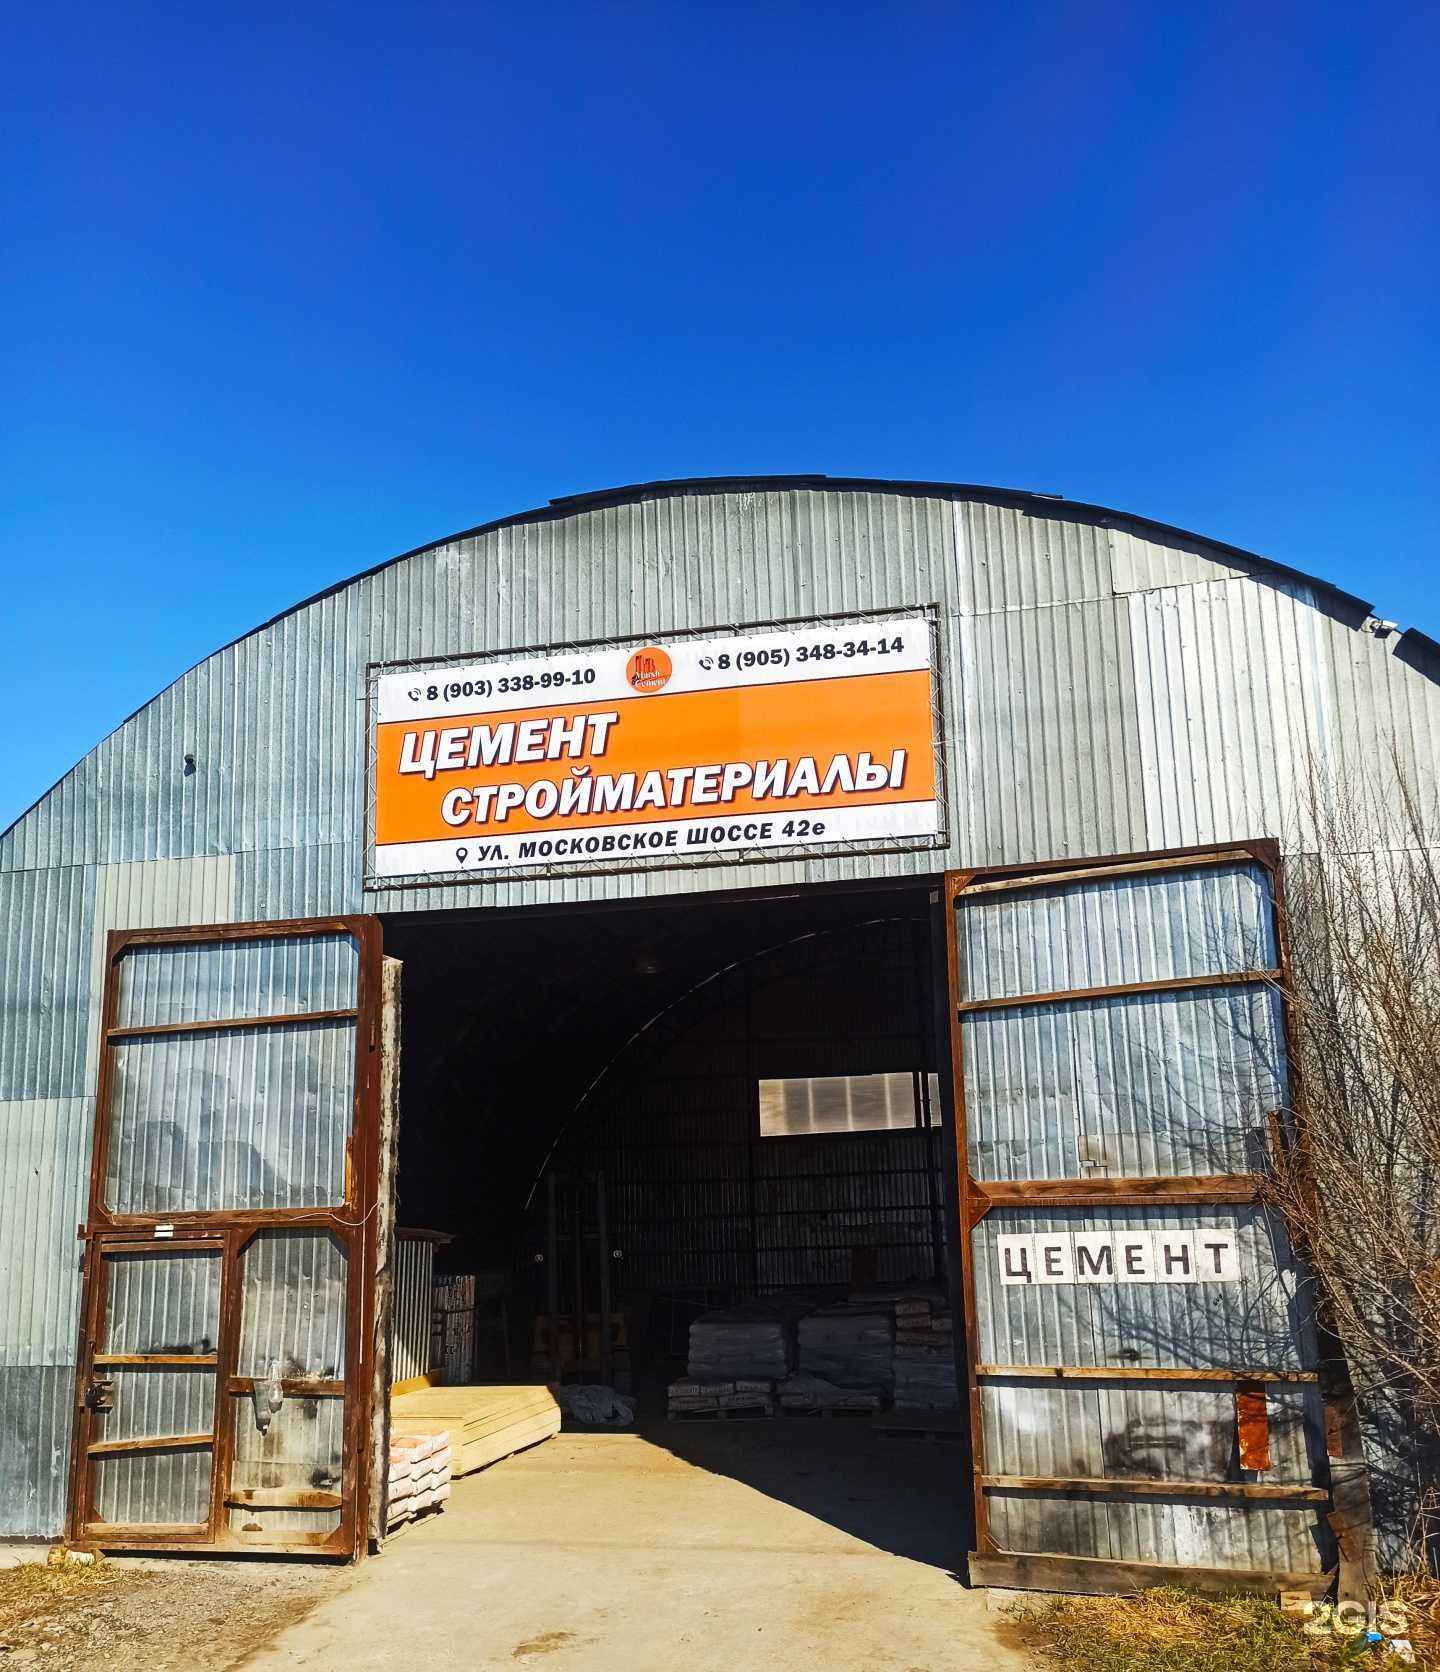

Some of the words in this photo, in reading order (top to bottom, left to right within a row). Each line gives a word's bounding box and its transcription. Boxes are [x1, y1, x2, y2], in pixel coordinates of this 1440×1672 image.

[718, 654, 731, 669] 8
[736, 648, 790, 671] (905)
[795, 636, 905, 662] 348-34-14
[426, 685, 439, 701] 8
[443, 679, 493, 702] (903)
[497, 668, 596, 693] 338-99-10
[398, 711, 619, 781] ЦЕМЕНТ
[441, 749, 908, 827] СТРОЙМАТЕРИАЛЫ
[477, 845, 510, 862] УЛ.
[518, 829, 678, 859] МОСКОВСКОЕ
[686, 822, 773, 845] ШОССЕ
[1004, 1243, 1229, 1283] ЦЕМЕНТ
